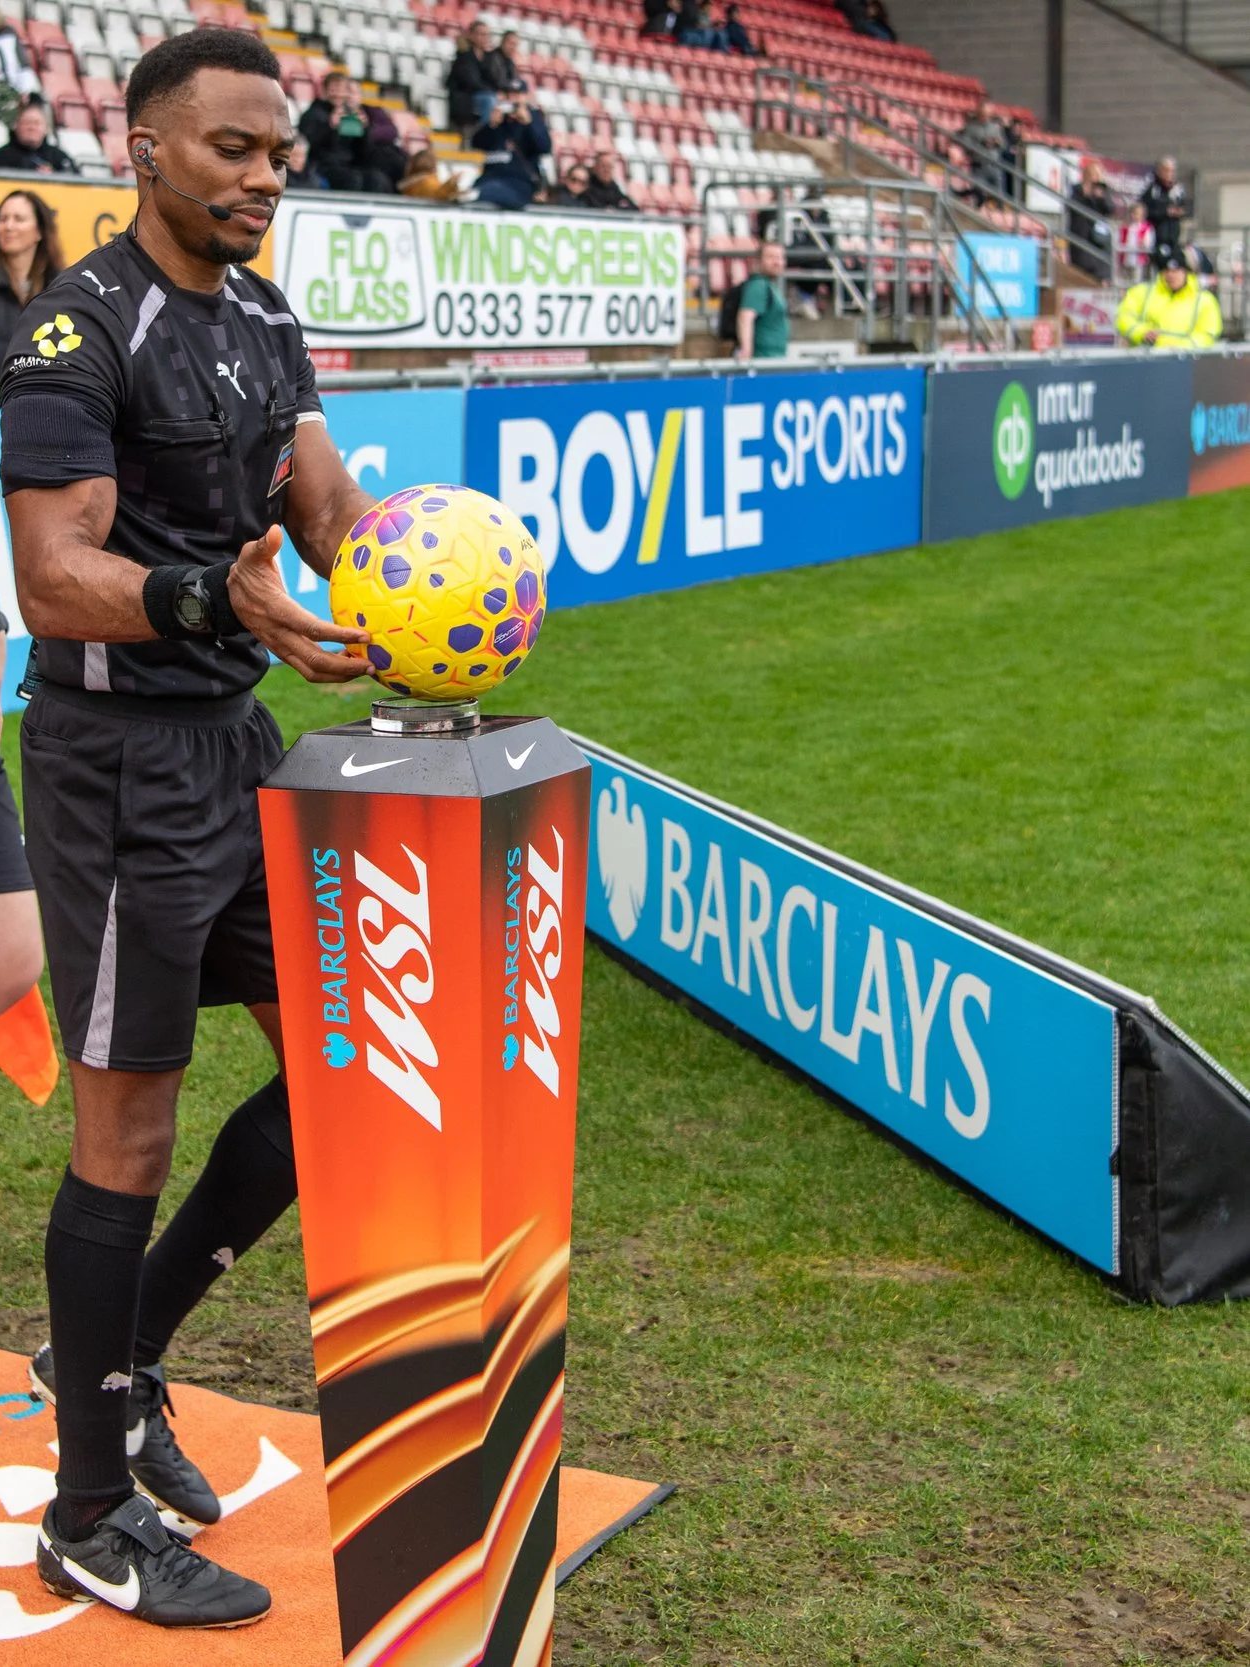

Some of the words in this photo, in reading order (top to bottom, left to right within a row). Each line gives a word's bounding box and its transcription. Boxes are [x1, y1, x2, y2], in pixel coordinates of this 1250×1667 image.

[306, 278, 410, 324] GLASS
[327, 230, 390, 278] FLO
[430, 218, 680, 289] WINDSCREENS
[433, 291, 523, 338] 0333
[535, 293, 592, 338] 577
[605, 293, 677, 336] 6004
[499, 403, 764, 576] BOYLE
[770, 391, 907, 490] SPORTS
[1034, 422, 1145, 508] quickbooks
[1207, 402, 1250, 447] BARCL
[312, 847, 351, 1025] BARCLAYS
[353, 843, 442, 1132] WSL
[503, 847, 522, 1025] BARCLAYS
[523, 825, 564, 1098] WSL
[660, 817, 991, 1140] BARCLAYS
